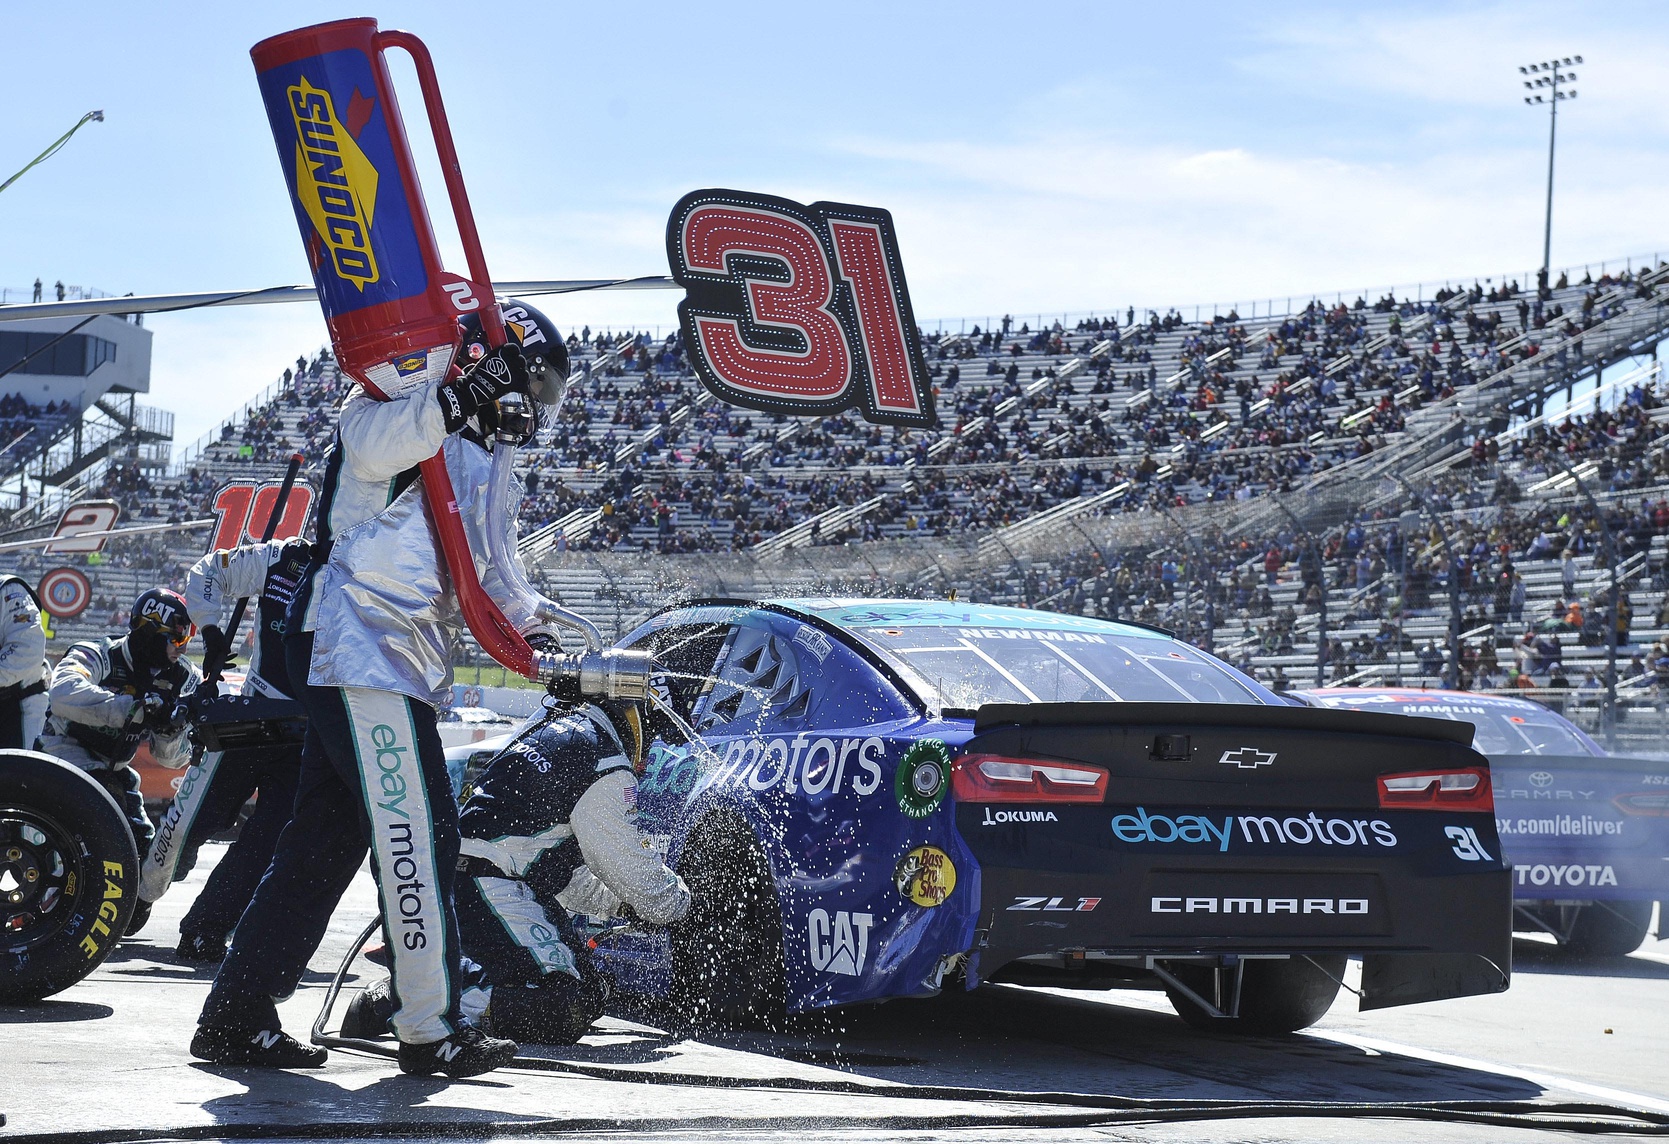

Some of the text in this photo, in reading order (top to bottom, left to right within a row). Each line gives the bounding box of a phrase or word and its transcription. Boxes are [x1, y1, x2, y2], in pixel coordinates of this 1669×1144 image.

[290, 89, 374, 280] SUNOCO
[681, 203, 922, 415] 31
[503, 306, 547, 348] CAT
[397, 357, 426, 370] SUNOCO
[443, 385, 461, 418] sparco
[46, 504, 118, 553] 2
[141, 598, 176, 624] CAT
[840, 611, 970, 623] ebay
[958, 628, 1108, 645] NEWMAN
[1323, 694, 1538, 711] FedEx Ground
[1403, 704, 1486, 715] HAMLIN
[902, 737, 949, 764] AMERICAN
[706, 736, 886, 796] motors
[1493, 789, 1596, 800] CAMRY
[899, 798, 940, 819] ETHANOL
[154, 809, 182, 867] motors
[371, 723, 428, 951] ebay motors
[1111, 806, 1398, 852] ebay motors
[1443, 825, 1495, 862] 31
[919, 848, 944, 869] Bass
[919, 868, 942, 884] Pro
[1514, 864, 1619, 887] TOYOTA
[918, 880, 947, 904] Shops
[1005, 896, 1102, 912] ZL1
[78, 860, 124, 960] EAGLE
[1151, 896, 1369, 915] CAMARO
[808, 907, 874, 977] CAT
